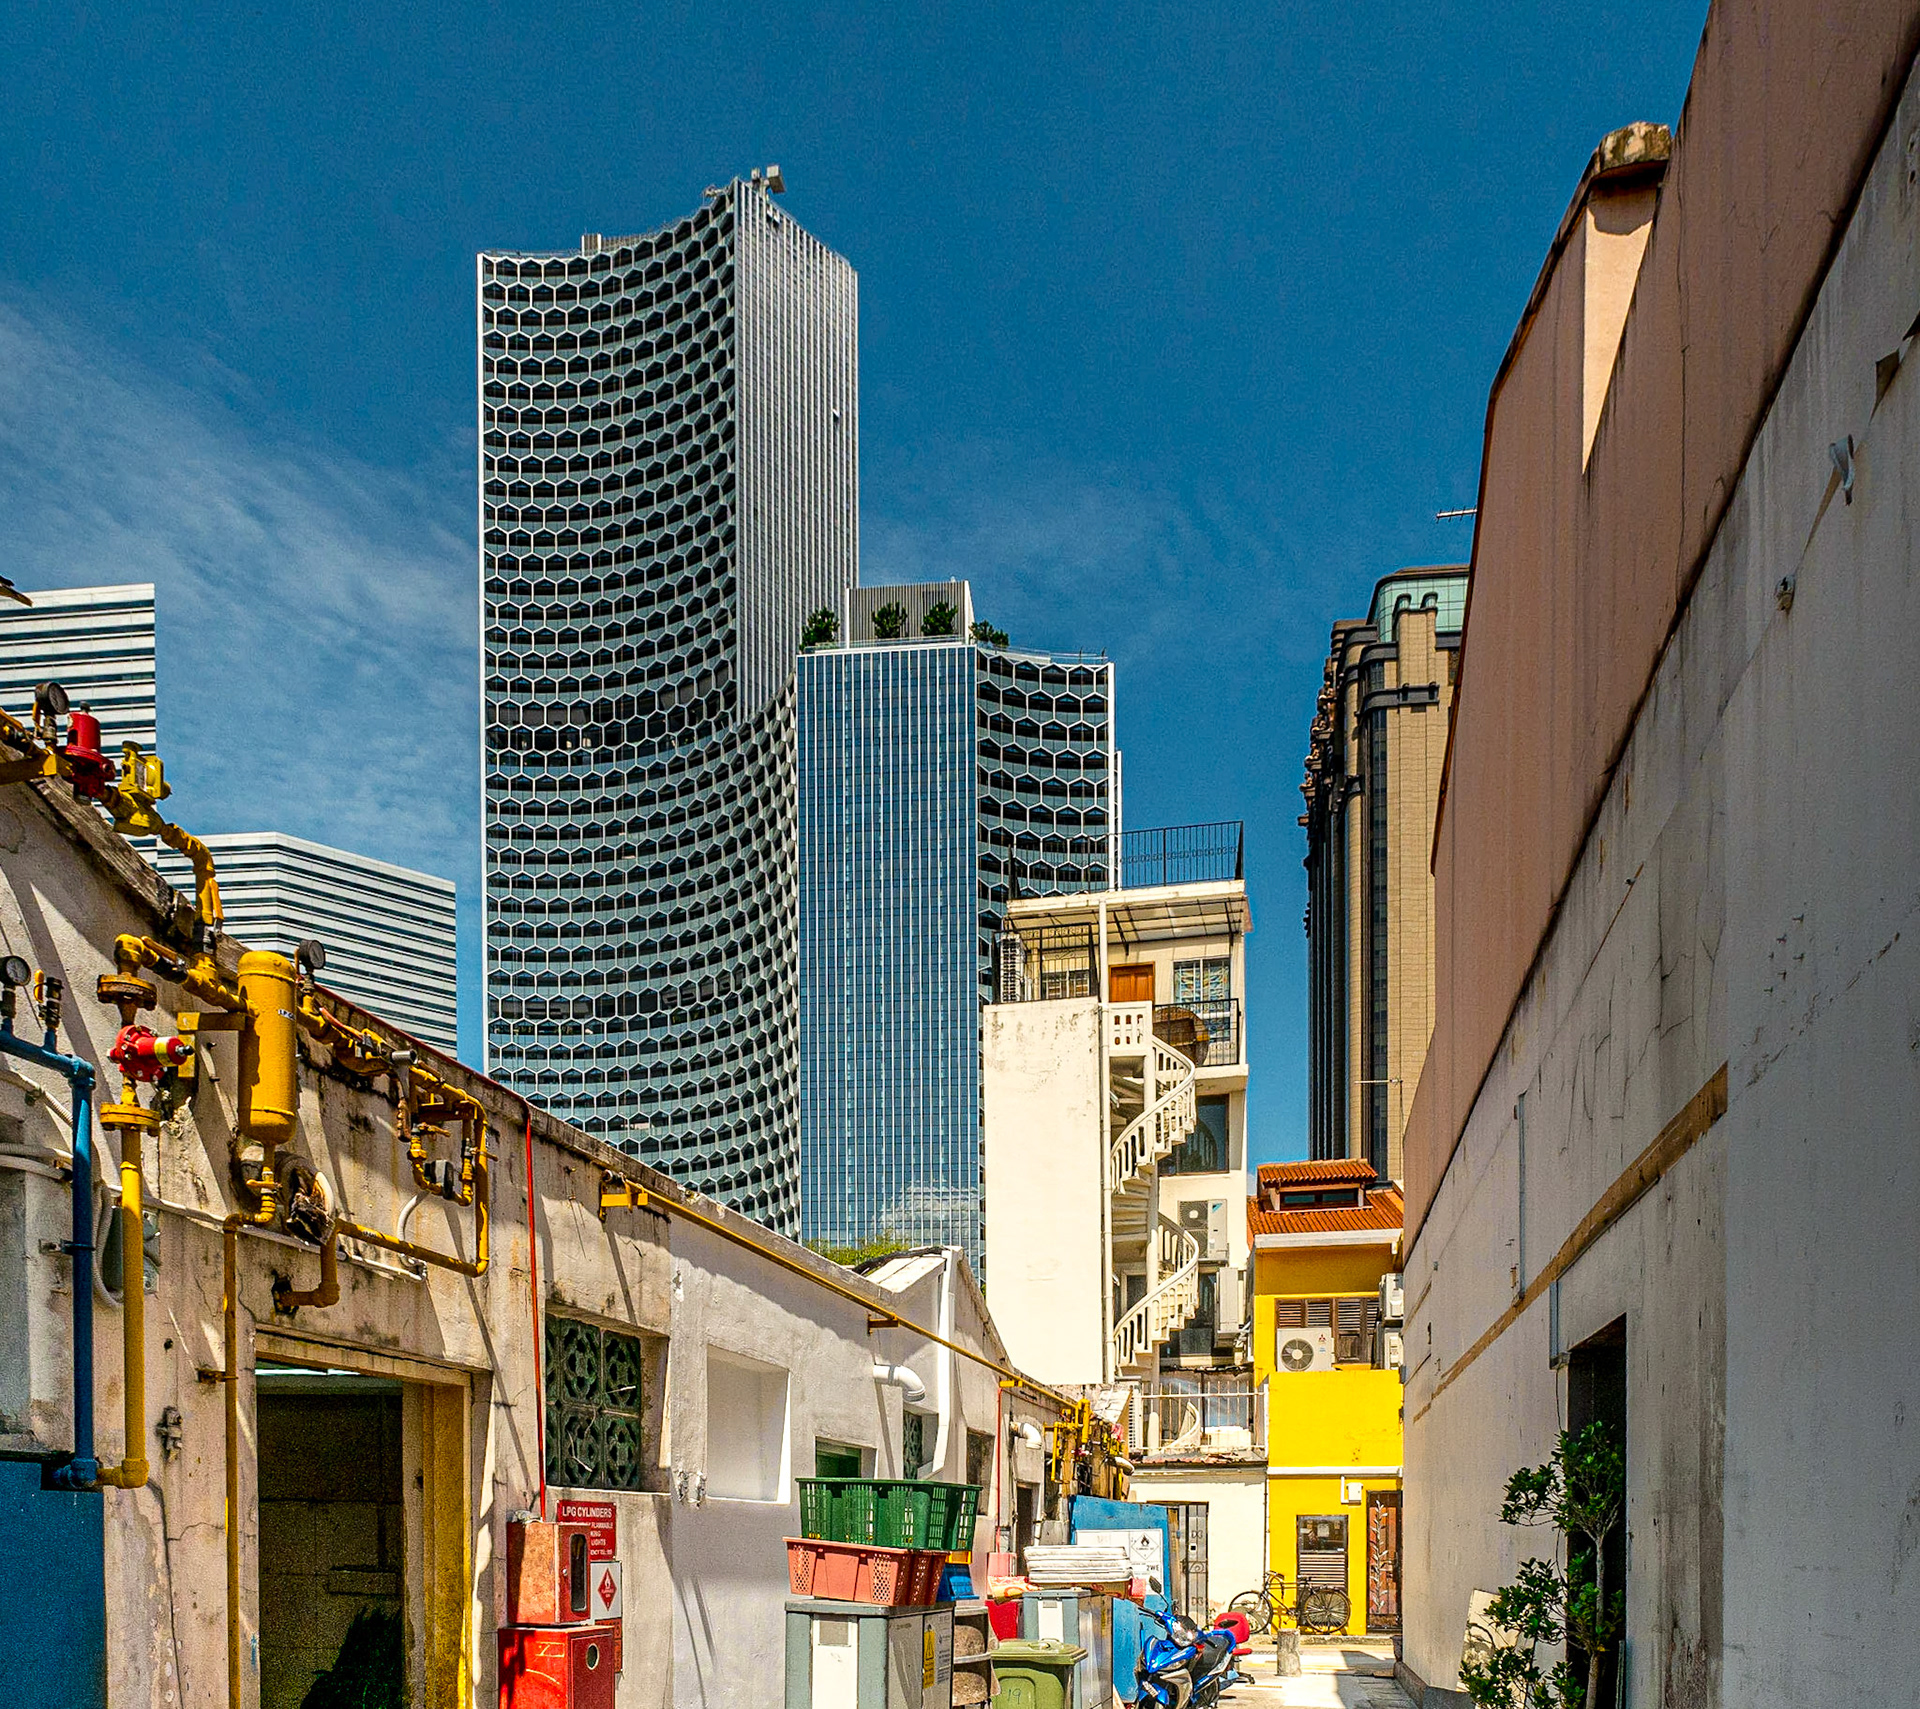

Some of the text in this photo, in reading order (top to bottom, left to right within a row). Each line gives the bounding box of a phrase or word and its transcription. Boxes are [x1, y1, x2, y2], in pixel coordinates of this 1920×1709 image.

[562, 1506, 612, 1518] LPG CYLINDERS
[1007, 1688, 1021, 1705] 19
